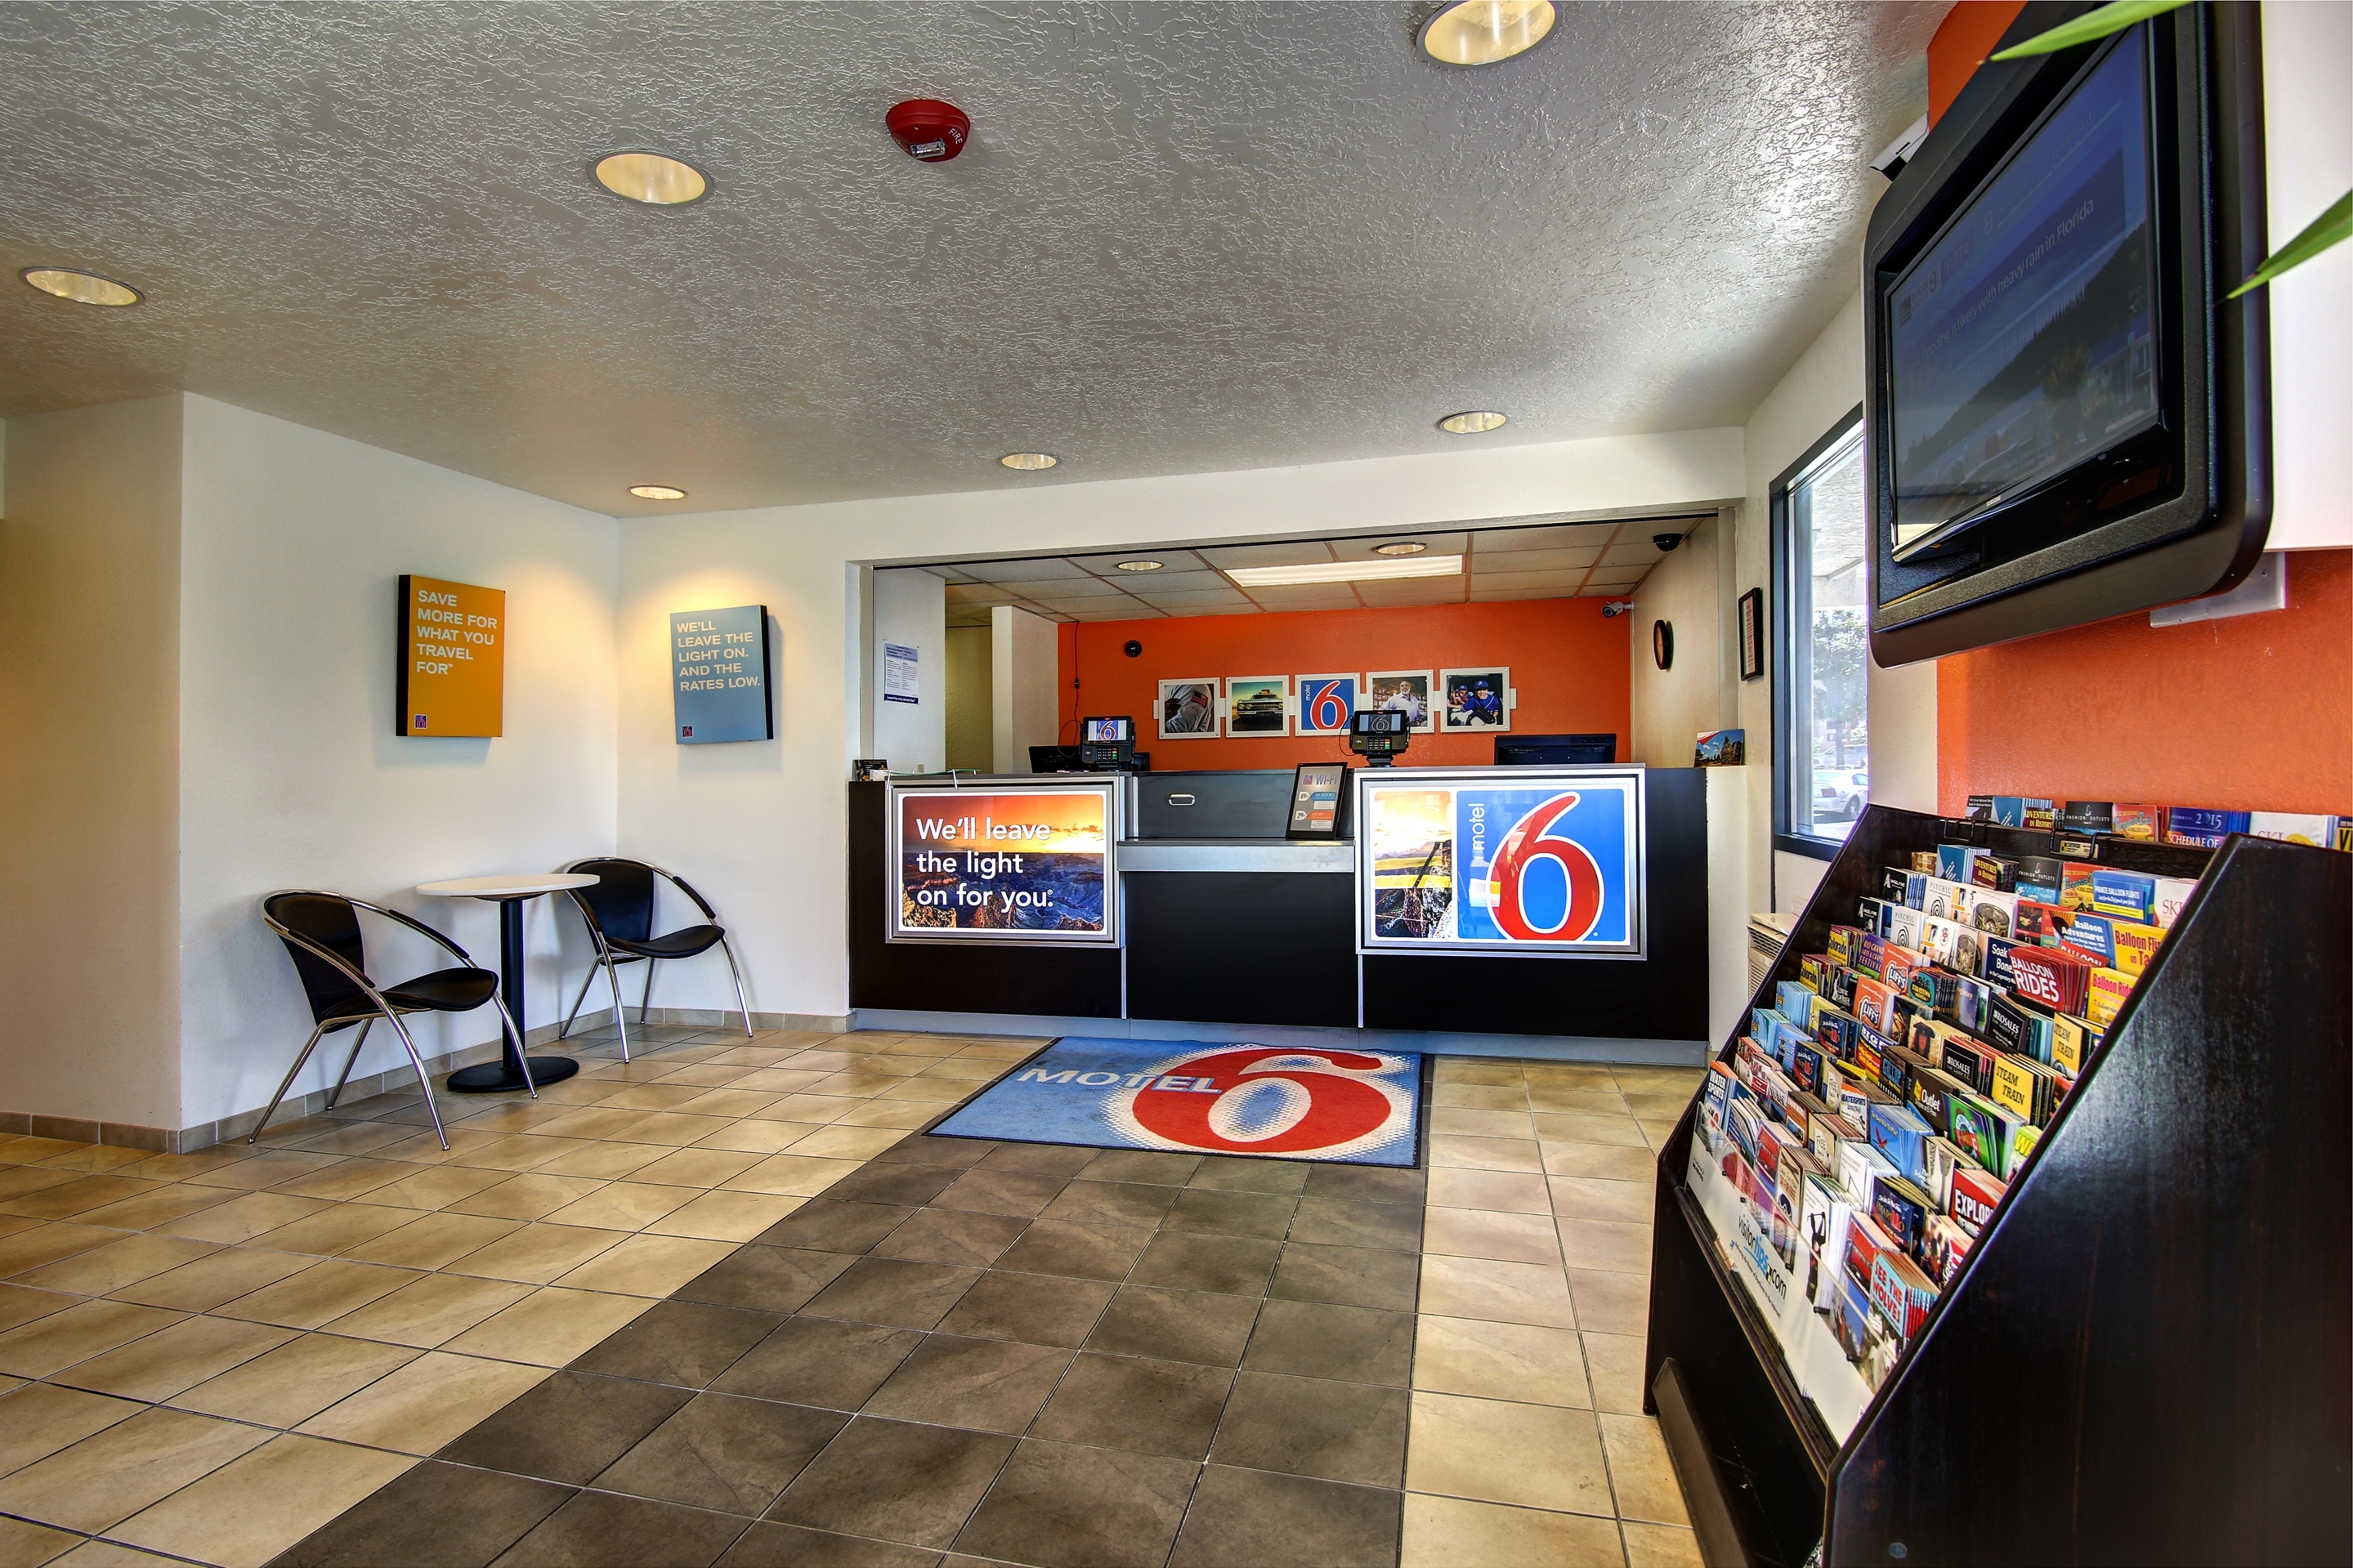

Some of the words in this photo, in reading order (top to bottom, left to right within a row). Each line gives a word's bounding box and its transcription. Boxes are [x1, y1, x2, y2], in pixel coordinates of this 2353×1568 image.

[948, 128, 963, 145] FIRE
[1921, 324, 1950, 365] Flooding
[1951, 317, 1957, 337] is
[1957, 297, 1978, 333] likely
[1977, 280, 1997, 313] with
[1997, 256, 2024, 298] heavy
[2025, 239, 2043, 270] rain
[2045, 228, 2056, 253] in
[2056, 193, 2093, 243] Florida
[1985, 495, 2002, 507] SAMSUNG
[418, 590, 458, 608] SAVE
[417, 608, 464, 626] MORE
[467, 614, 498, 630] FOR
[417, 625, 459, 642] WHAT
[463, 631, 495, 646] YOU
[677, 633, 722, 648] LEAVE
[724, 631, 754, 644] THE
[417, 643, 473, 660] TRAVEL
[678, 648, 719, 663] LIGHT
[723, 646, 749, 659] ON.
[679, 663, 710, 677] AND
[713, 662, 742, 675] THE
[680, 677, 725, 691] RATES
[727, 675, 761, 688] LOW.
[1309, 680, 1348, 730] 6
[1099, 720, 1116, 740] 6
[1371, 714, 1389, 732] 6
[1316, 774, 1338, 785] WI-FI
[2024, 810, 2055, 821] ADVENTURES
[985, 816, 1051, 841] leave
[1468, 803, 1485, 851] motel
[2168, 834, 2206, 847] SCHEDULE
[915, 851, 957, 873] the
[966, 851, 1024, 880] light
[1485, 791, 1605, 941] 6
[2018, 870, 2036, 878] FASHION
[2038, 873, 2056, 882] OUTLETS
[916, 887, 948, 905] on
[956, 882, 993, 906] for
[1930, 882, 1952, 895] PSYCHIC
[2109, 887, 2126, 896] BALLOON
[1894, 912, 1914, 922] PSYCHIC
[2074, 920, 2103, 933] Balloon
[1863, 940, 1872, 949] RIO
[2061, 927, 2105, 943] Adventures
[2114, 930, 2147, 950] Balloon
[1827, 936, 1847, 956] Colorado
[1862, 949, 1870, 957] ARTS
[1992, 944, 2008, 958] Soak
[1859, 955, 1882, 972] FESTIVAL
[2011, 957, 2055, 980] BALLOON
[2130, 954, 2137, 963] in
[2013, 969, 2060, 1003] RIDES
[2093, 973, 2118, 994] Balloon
[1997, 1011, 2020, 1034] ROSALES
[1861, 1025, 1879, 1045] BIG
[2057, 1041, 2075, 1061] TRAIN
[1948, 1057, 1971, 1074] ROSALES
[1017, 1068, 1223, 1094] MOTEL
[1710, 1069, 1727, 1089] WATER
[1996, 1065, 2020, 1087] STEAM
[1132, 1048, 1392, 1153] 6
[1707, 1082, 1724, 1100] SPORTS
[1921, 1089, 1941, 1112] Outlet
[2002, 1084, 2025, 1106] TRAIN
[1874, 1262, 1887, 1284] SEE
[1889, 1279, 1903, 1305] THE
[1872, 1282, 1901, 1321] WOLVES
